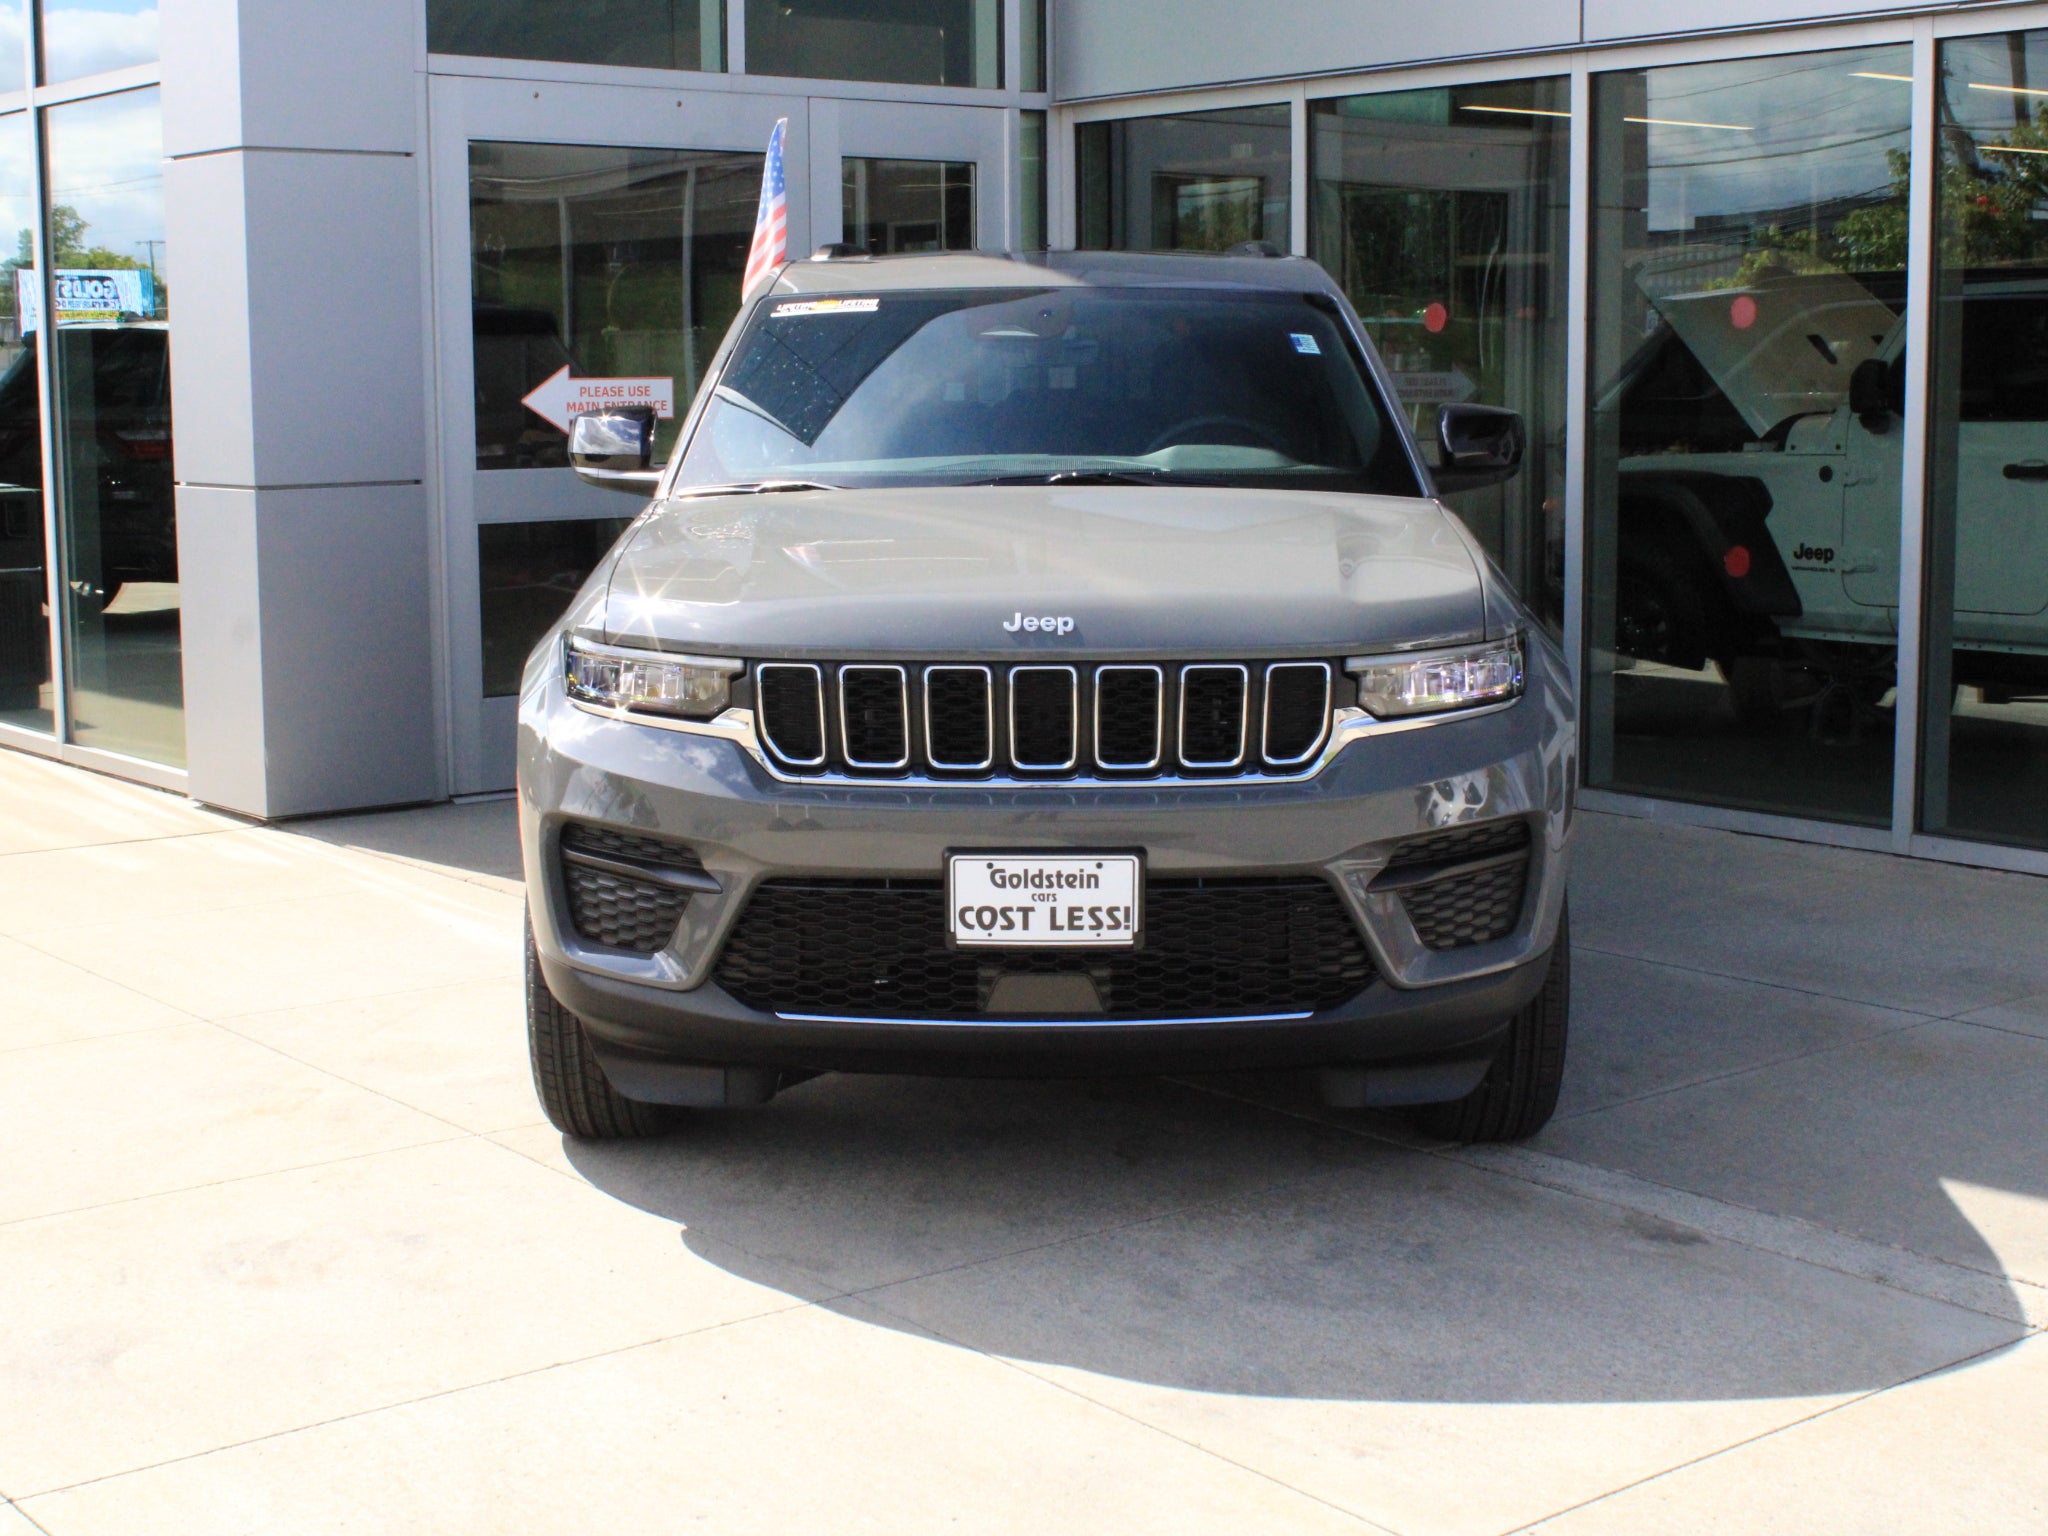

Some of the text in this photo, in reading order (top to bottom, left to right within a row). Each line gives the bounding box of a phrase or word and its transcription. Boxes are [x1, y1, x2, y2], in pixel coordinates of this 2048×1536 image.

[580, 386, 650, 398] PLEASE USE
[566, 401, 600, 413] MAIN
[1793, 542, 1834, 564] Jeep
[1003, 612, 1075, 636] Jeep
[990, 868, 1100, 889] Goldstein
[1031, 892, 1058, 903] cars
[958, 905, 1131, 931] COST LESS!
